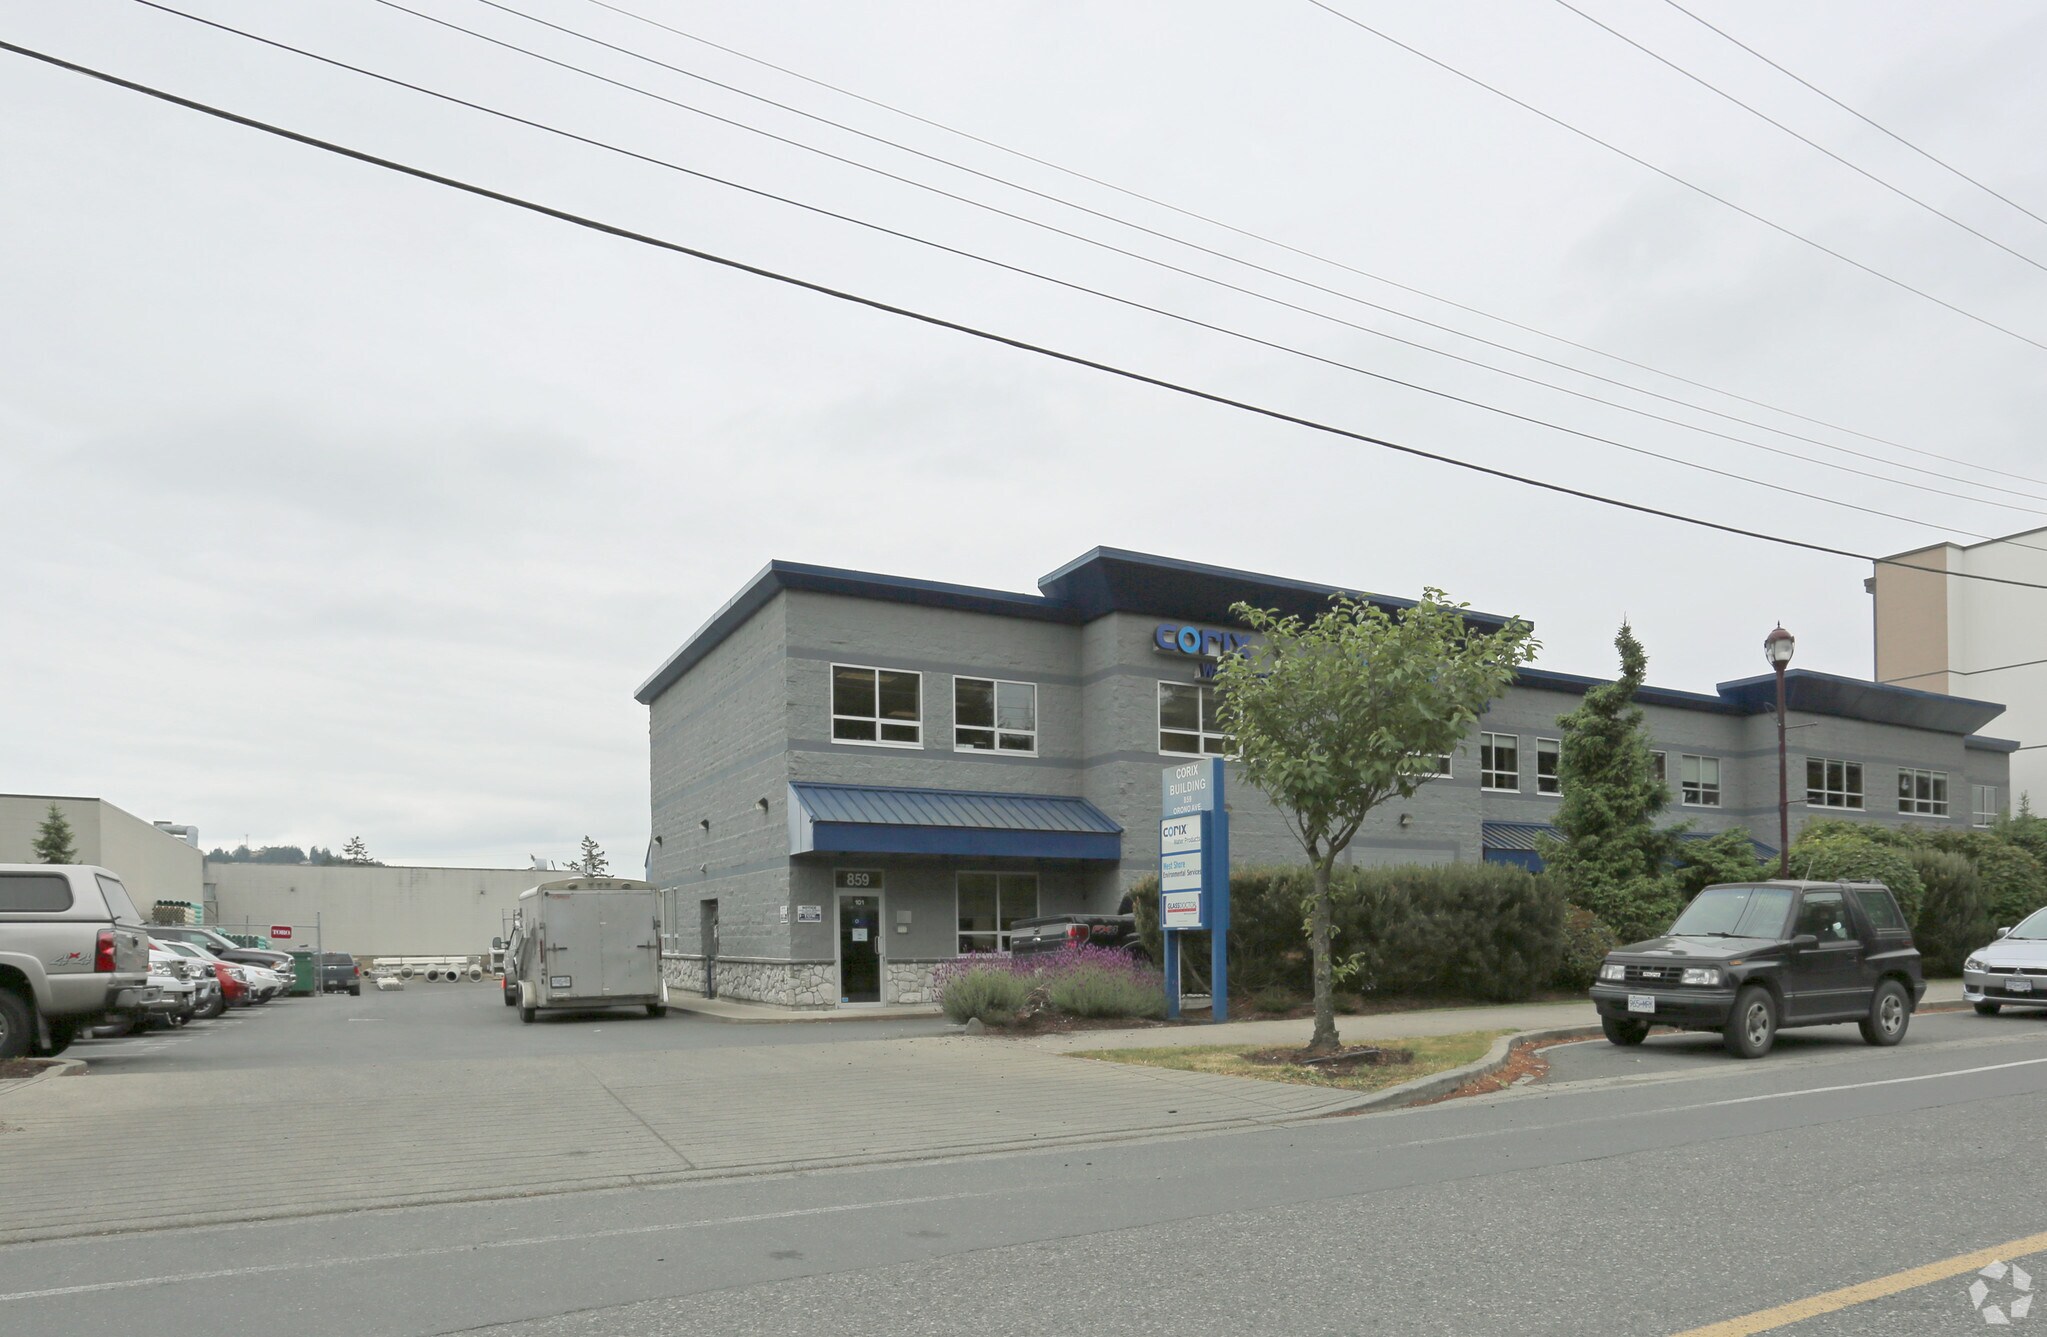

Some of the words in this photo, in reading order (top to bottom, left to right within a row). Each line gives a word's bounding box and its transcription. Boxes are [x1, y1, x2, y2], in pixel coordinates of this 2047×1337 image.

[1176, 764, 1198, 779] CORIX
[1169, 778, 1206, 796] BUILDING
[847, 873, 870, 886] 859
